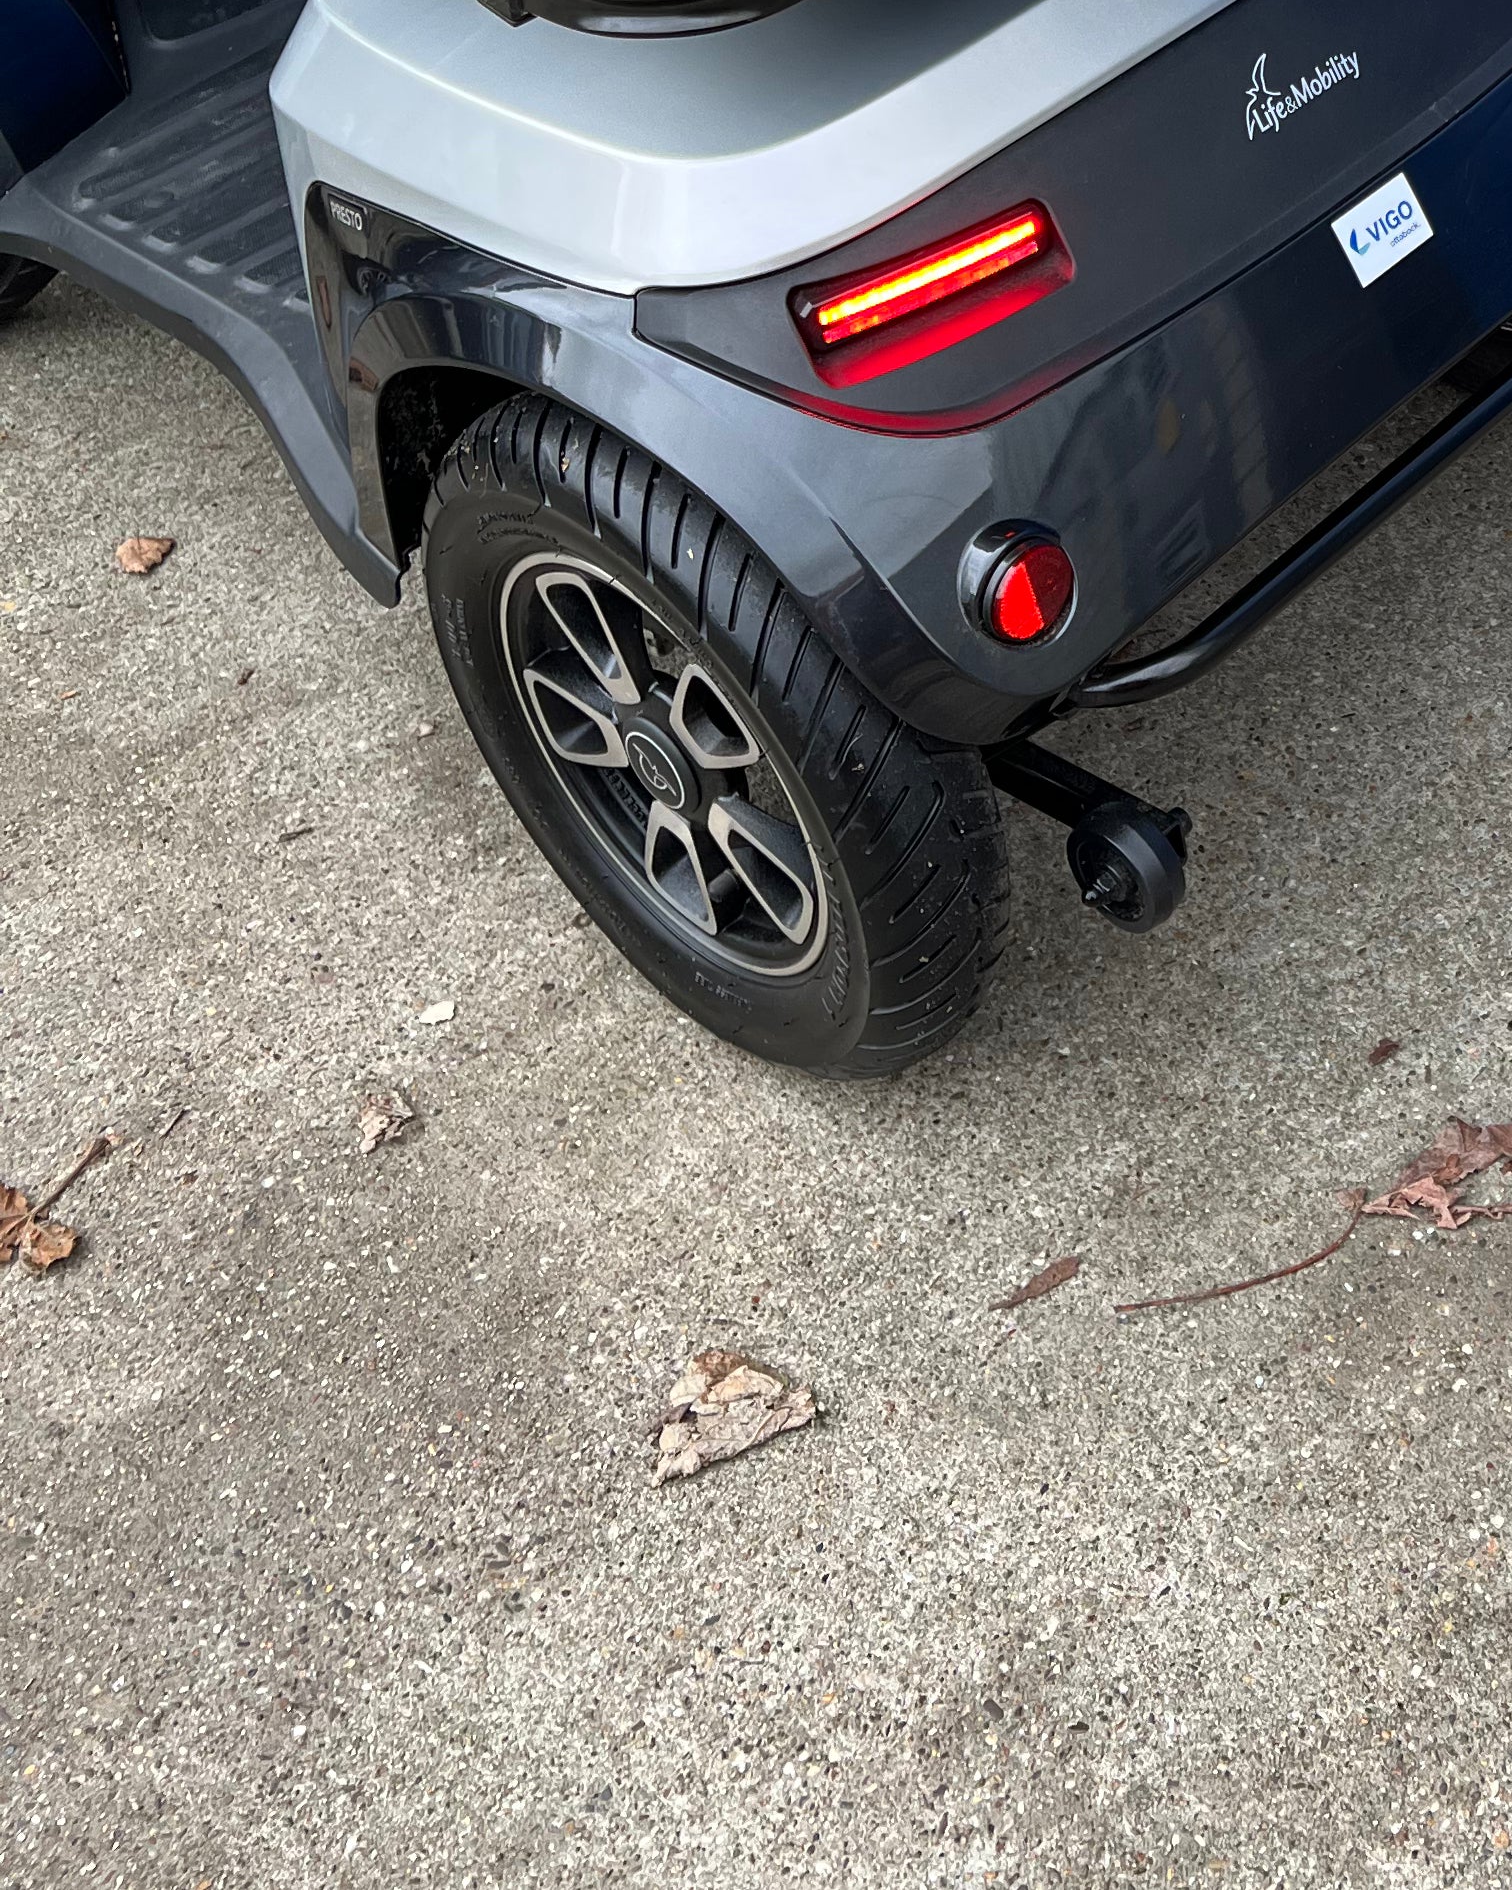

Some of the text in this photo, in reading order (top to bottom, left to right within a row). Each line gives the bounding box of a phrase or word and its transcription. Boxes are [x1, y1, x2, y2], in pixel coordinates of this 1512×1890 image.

[1251, 51, 1360, 133] Life&Mobility
[329, 200, 363, 231] PRESTO
[1365, 200, 1413, 242] VIGO
